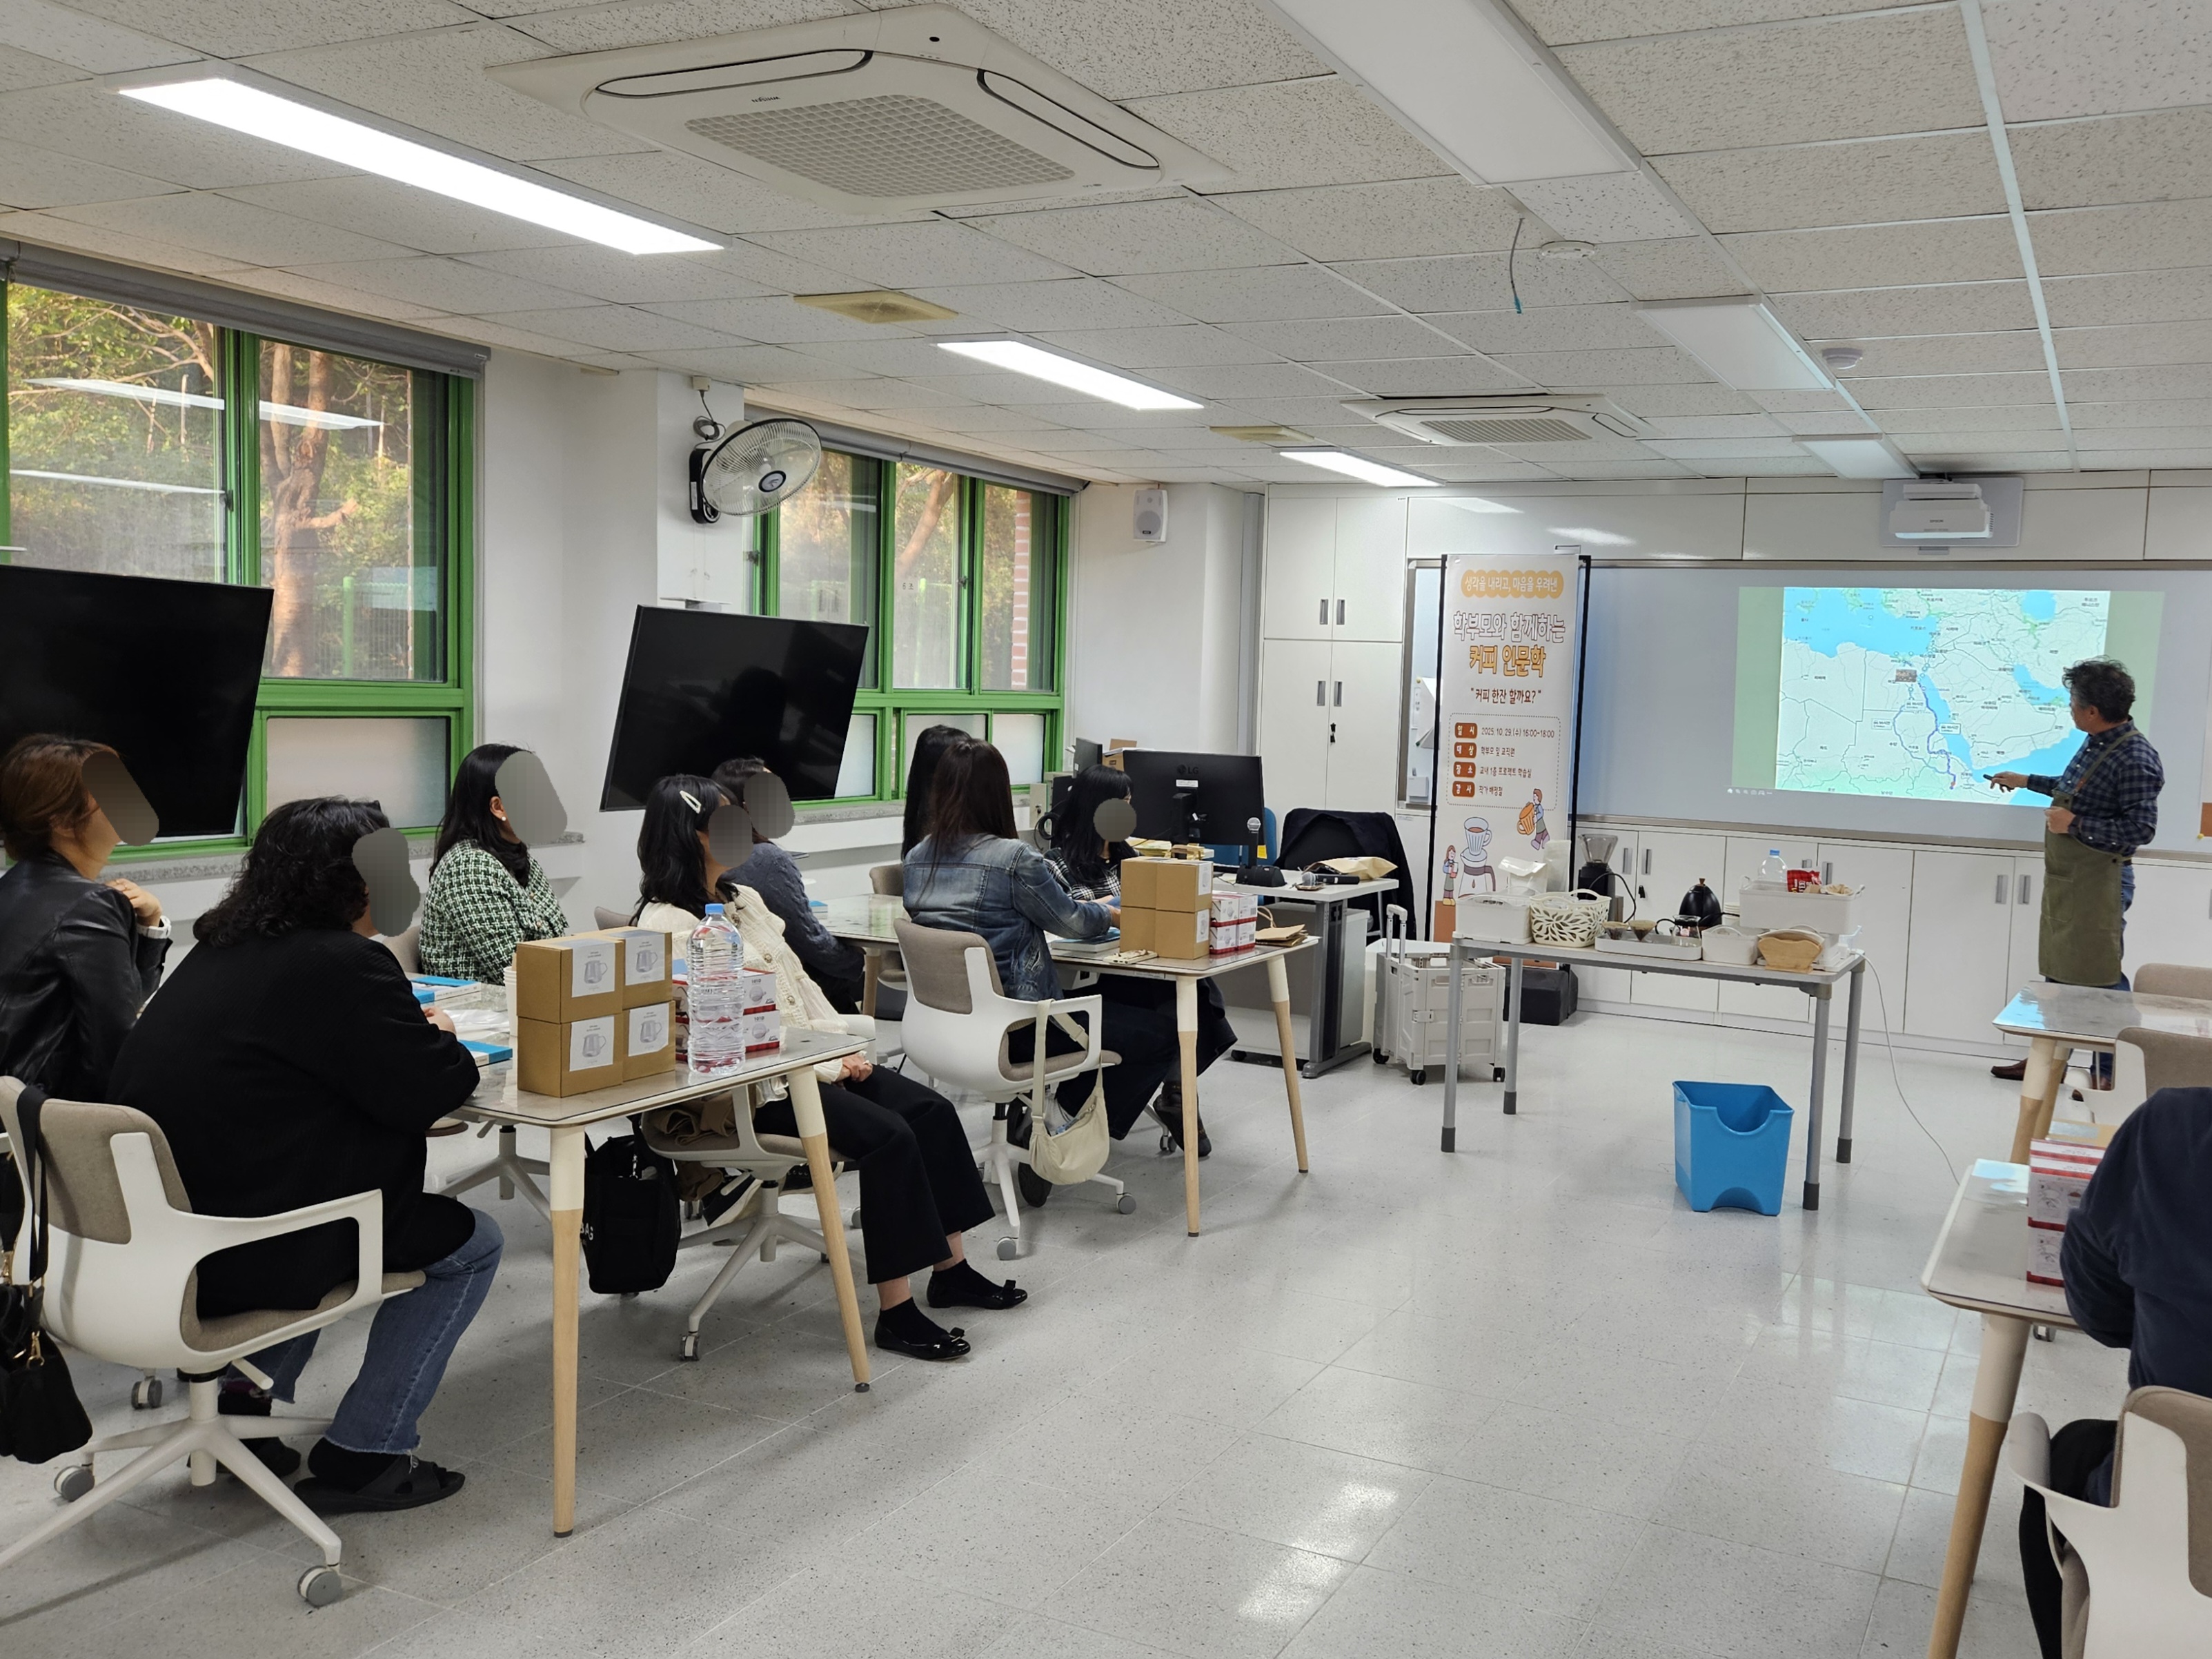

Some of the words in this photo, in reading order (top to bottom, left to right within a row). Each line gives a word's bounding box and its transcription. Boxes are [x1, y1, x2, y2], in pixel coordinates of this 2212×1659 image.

[1465, 576, 1486, 591] 생각을
[1488, 576, 1511, 593] 내리고,
[1512, 576, 1534, 592] 마음을
[1536, 577, 1558, 593] 우려낸
[1453, 611, 1507, 642] 학부모와
[1510, 612, 1566, 643] 함께하는
[1469, 645, 1498, 675] 커피
[1501, 644, 1547, 678] 인문학
[1492, 688, 1507, 704] 한잔
[1480, 766, 1489, 775] 교내
[1498, 767, 1517, 777] 프로젝트
[1518, 768, 1532, 778] 학습실
